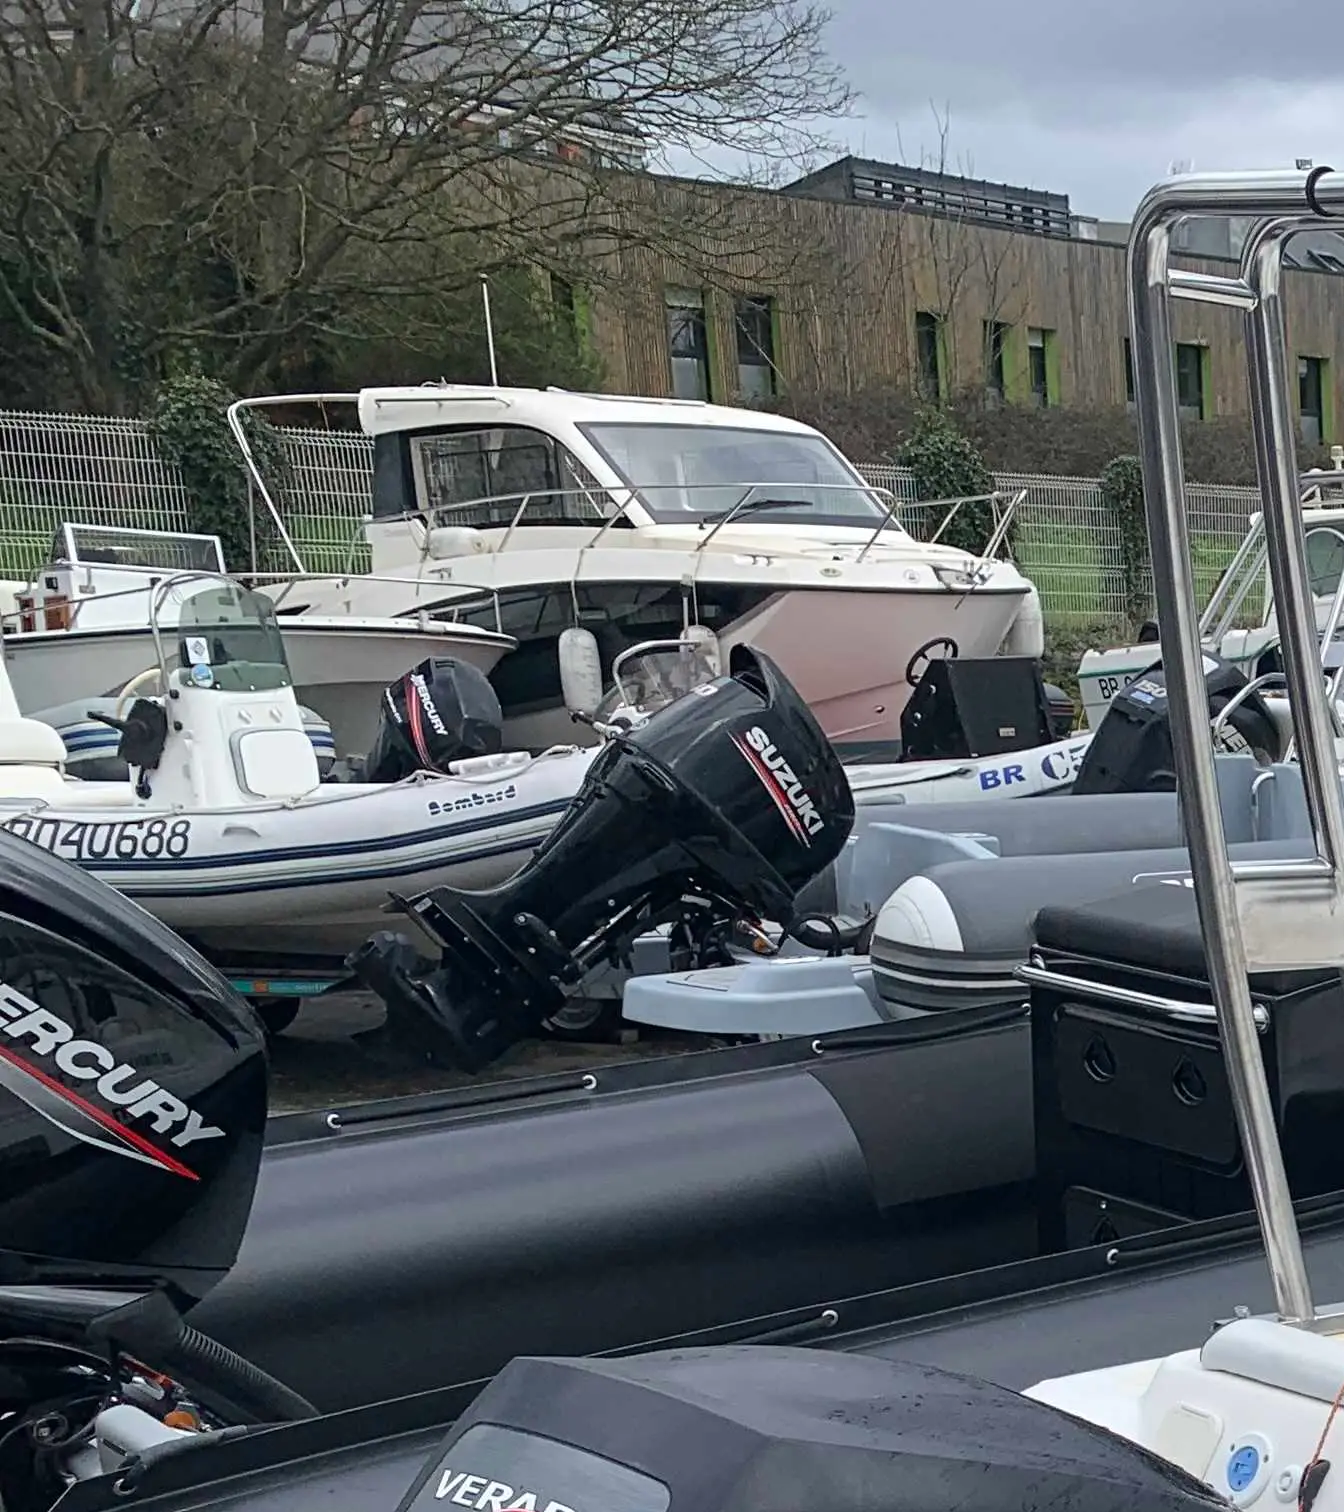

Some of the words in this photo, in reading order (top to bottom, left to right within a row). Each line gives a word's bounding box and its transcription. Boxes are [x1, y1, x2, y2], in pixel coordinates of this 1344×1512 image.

[1098, 677, 1119, 699] BR
[745, 726, 825, 836] SUZUKI
[980, 764, 1026, 791] BR
[0, 980, 226, 1148] ERCURY
